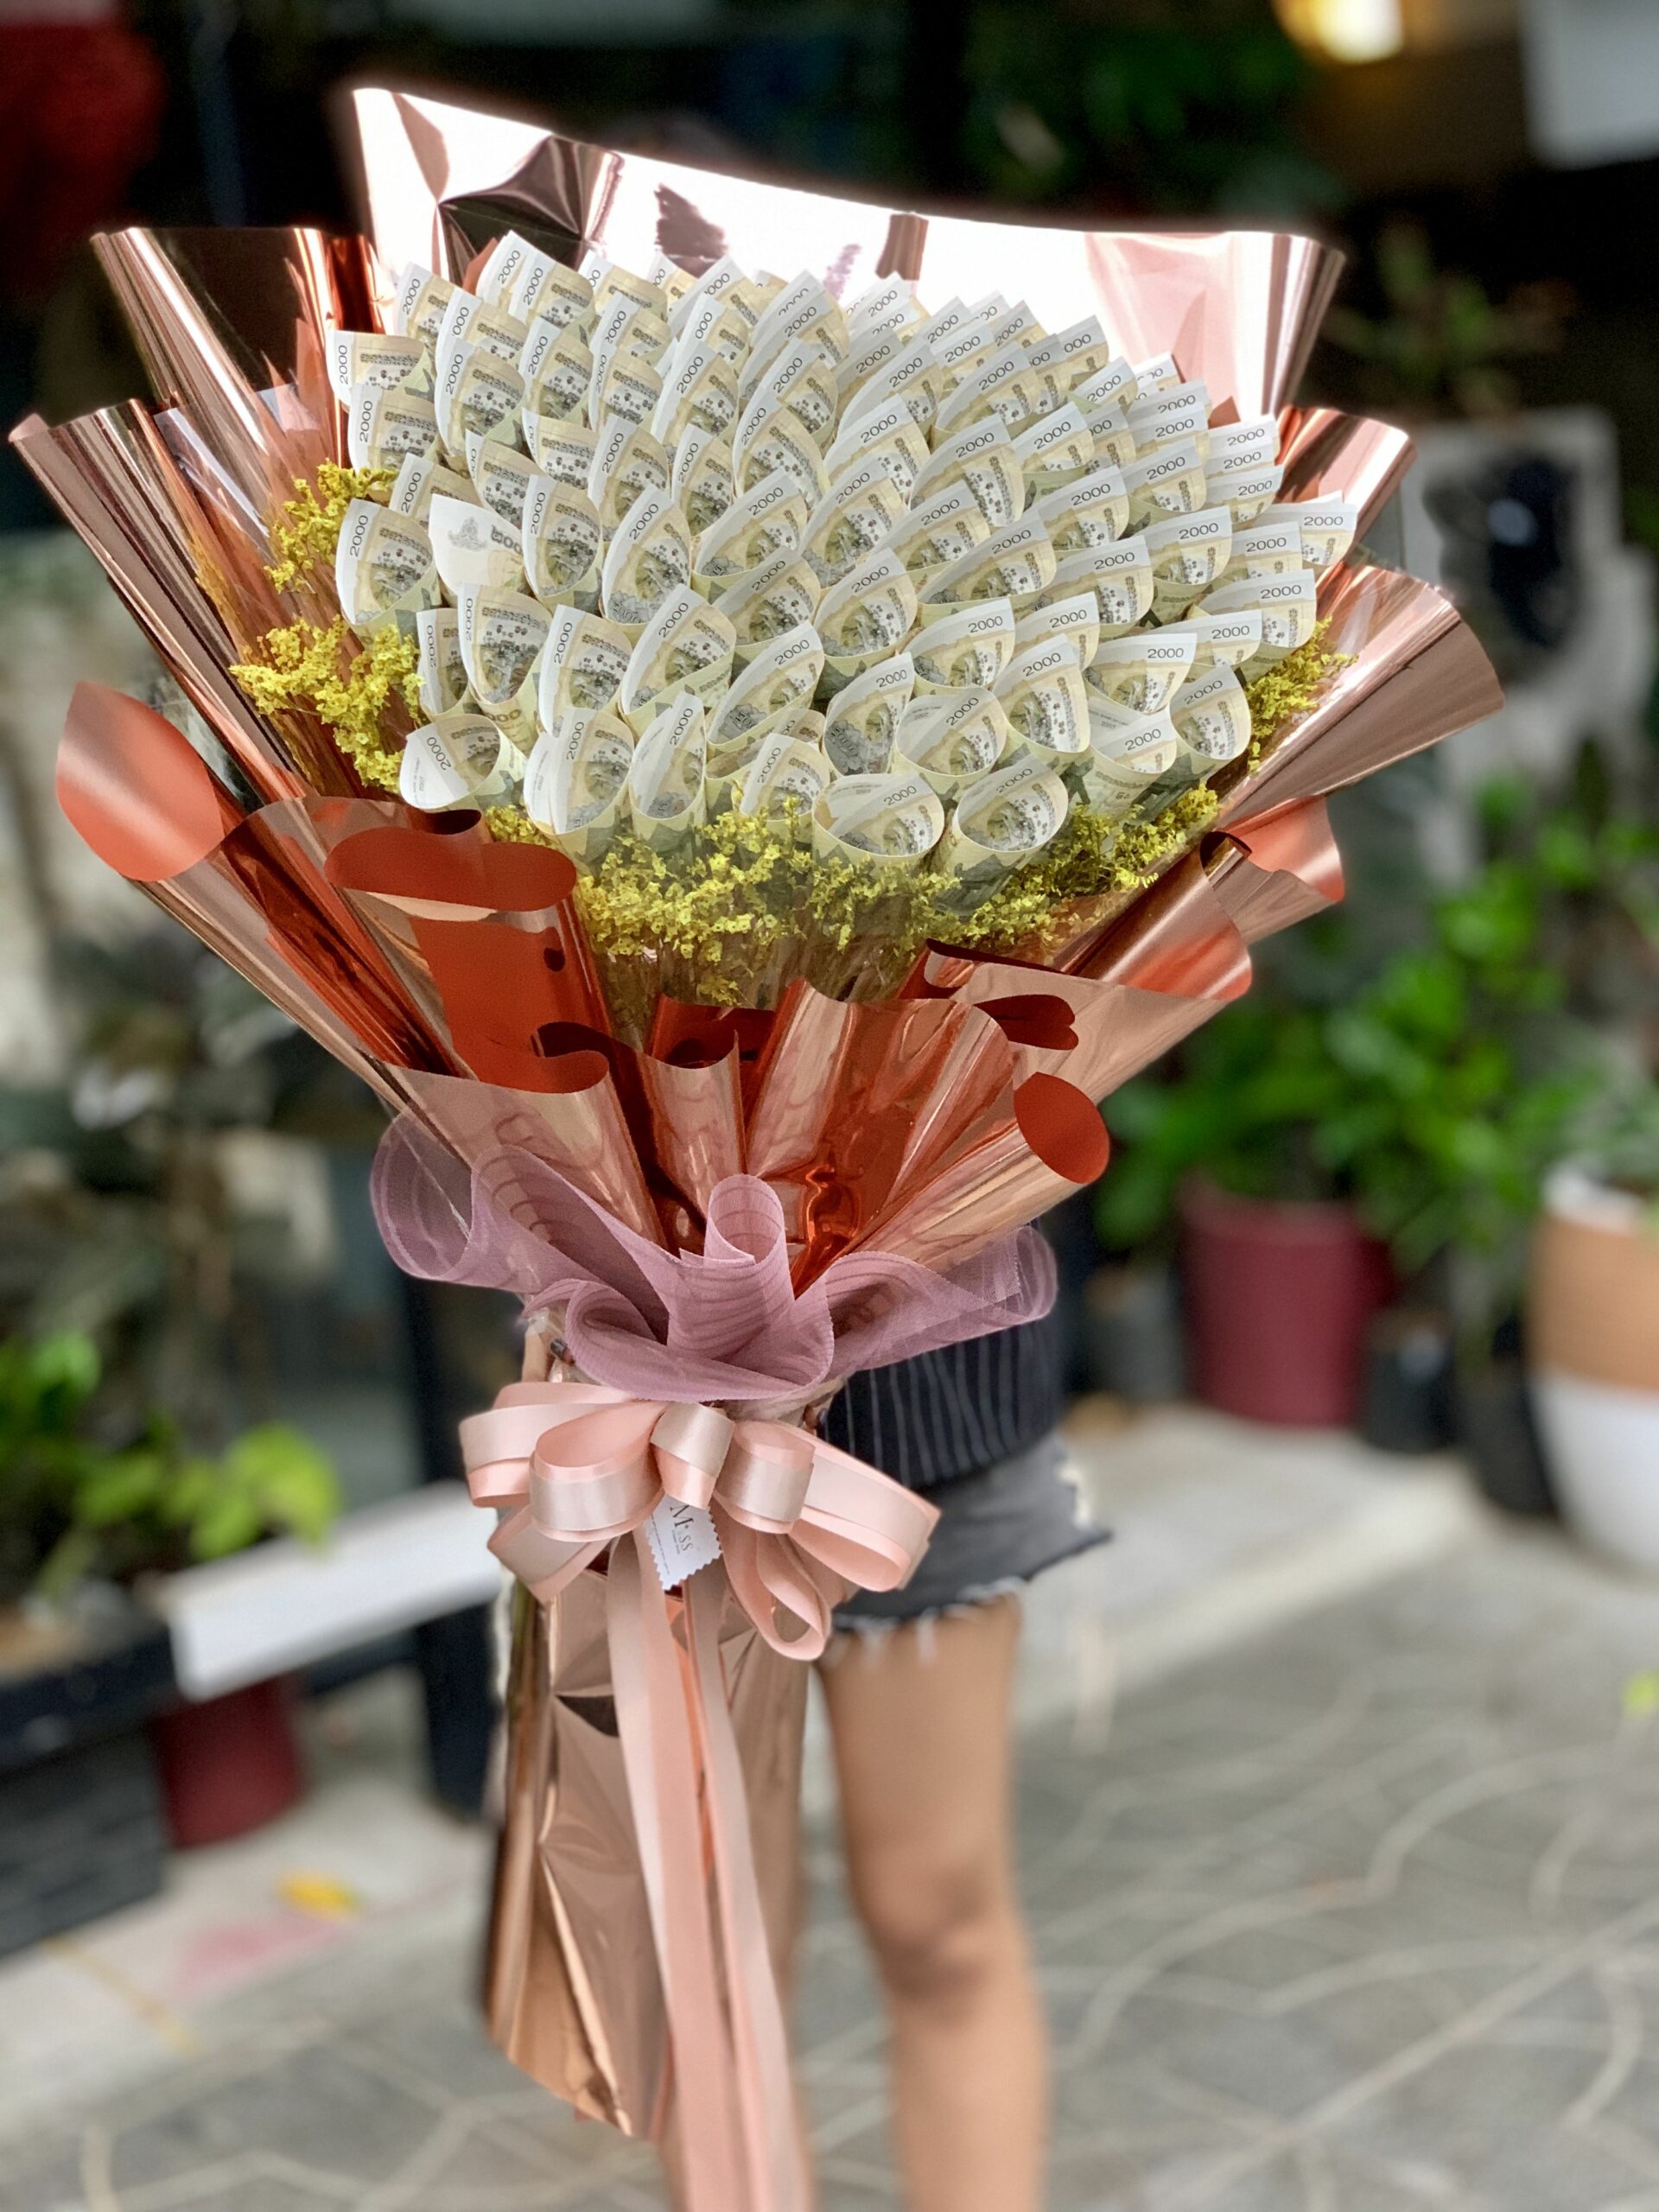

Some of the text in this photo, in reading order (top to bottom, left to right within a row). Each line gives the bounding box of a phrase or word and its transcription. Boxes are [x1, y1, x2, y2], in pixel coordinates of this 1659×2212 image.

[498, 251, 520, 284] 2000
[403, 279, 420, 315] 2000
[524, 268, 543, 305] 2000
[704, 273, 729, 296] 000
[868, 290, 897, 317] 2000
[453, 307, 469, 336] 000
[695, 312, 712, 340] 000
[785, 307, 817, 338] 2000
[928, 315, 958, 344] 2000
[995, 318, 1023, 346] 2000
[529, 336, 548, 375] 2000
[944, 336, 981, 363] 2000
[1065, 334, 1091, 353] 000
[339, 345, 347, 385] 2000
[856, 346, 890, 373] 2000
[889, 357, 922, 388] 2000
[446, 354, 463, 395] 2000
[677, 356, 703, 394] 2000
[773, 358, 802, 394] 2000
[979, 361, 1014, 391] 2000
[1087, 375, 1121, 402] 2000
[359, 401, 372, 442] 2000
[741, 408, 766, 445] 2000
[861, 415, 897, 443] 2000
[1034, 422, 1071, 449] 2000
[1155, 419, 1194, 438] 2000
[956, 433, 995, 458] 2000
[1227, 429, 1264, 446] 2000
[602, 433, 624, 474] 2000
[678, 442, 699, 483] 2000
[1224, 452, 1262, 469] 2000
[1147, 456, 1185, 480] 2000
[401, 472, 422, 513] 2000
[747, 487, 783, 516] 2000
[836, 473, 870, 504] 2000
[1071, 484, 1110, 505] 2000
[1238, 480, 1272, 496] 2000
[531, 493, 546, 535] 2000
[629, 504, 658, 540] 2000
[920, 499, 960, 525] 2000
[1304, 516, 1343, 526] 2000
[350, 515, 368, 557] 2000
[992, 530, 1031, 554] 2000
[1179, 523, 1218, 539] 2000
[1246, 537, 1287, 552] 2000
[1094, 552, 1135, 569] 2000
[752, 561, 785, 591] 2000
[851, 566, 889, 593] 2000
[1261, 585, 1301, 599] 2000
[658, 602, 689, 638] 2000
[968, 616, 1003, 633] 2000
[1050, 609, 1087, 628] 2000
[1211, 626, 1249, 639] 2000
[427, 625, 435, 668] 2000
[554, 622, 573, 664] 2000
[774, 639, 810, 665] 2000
[1147, 648, 1184, 658] 2000
[1023, 652, 1061, 677] 2000
[876, 670, 907, 688] 2000
[1184, 680, 1223, 705] 2000
[945, 697, 979, 726] 2000
[567, 721, 584, 760] 2000
[671, 709, 693, 746] 2000
[1125, 728, 1161, 751] 2000
[427, 737, 451, 770] 2000
[758, 747, 781, 783] 2000
[996, 768, 1033, 793] 2000
[884, 785, 917, 805] 2000
